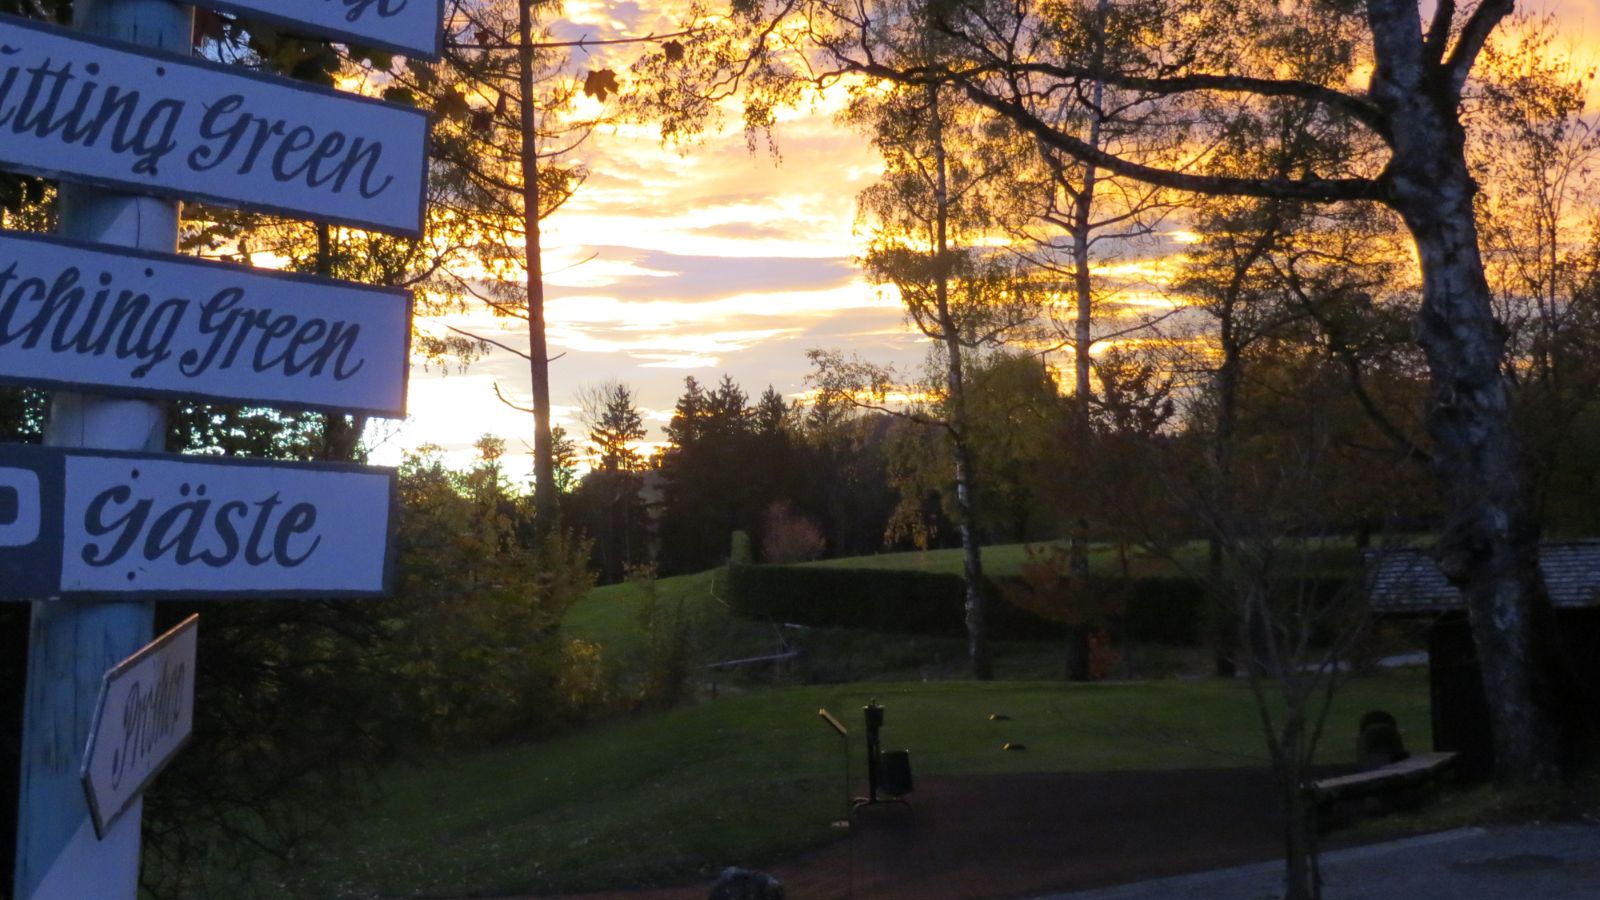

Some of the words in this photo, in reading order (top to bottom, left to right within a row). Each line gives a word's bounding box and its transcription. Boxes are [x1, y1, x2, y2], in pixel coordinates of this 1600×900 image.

[187, 94, 393, 198] Green
[179, 286, 364, 381] Green
[81, 482, 321, 568] Gäste
